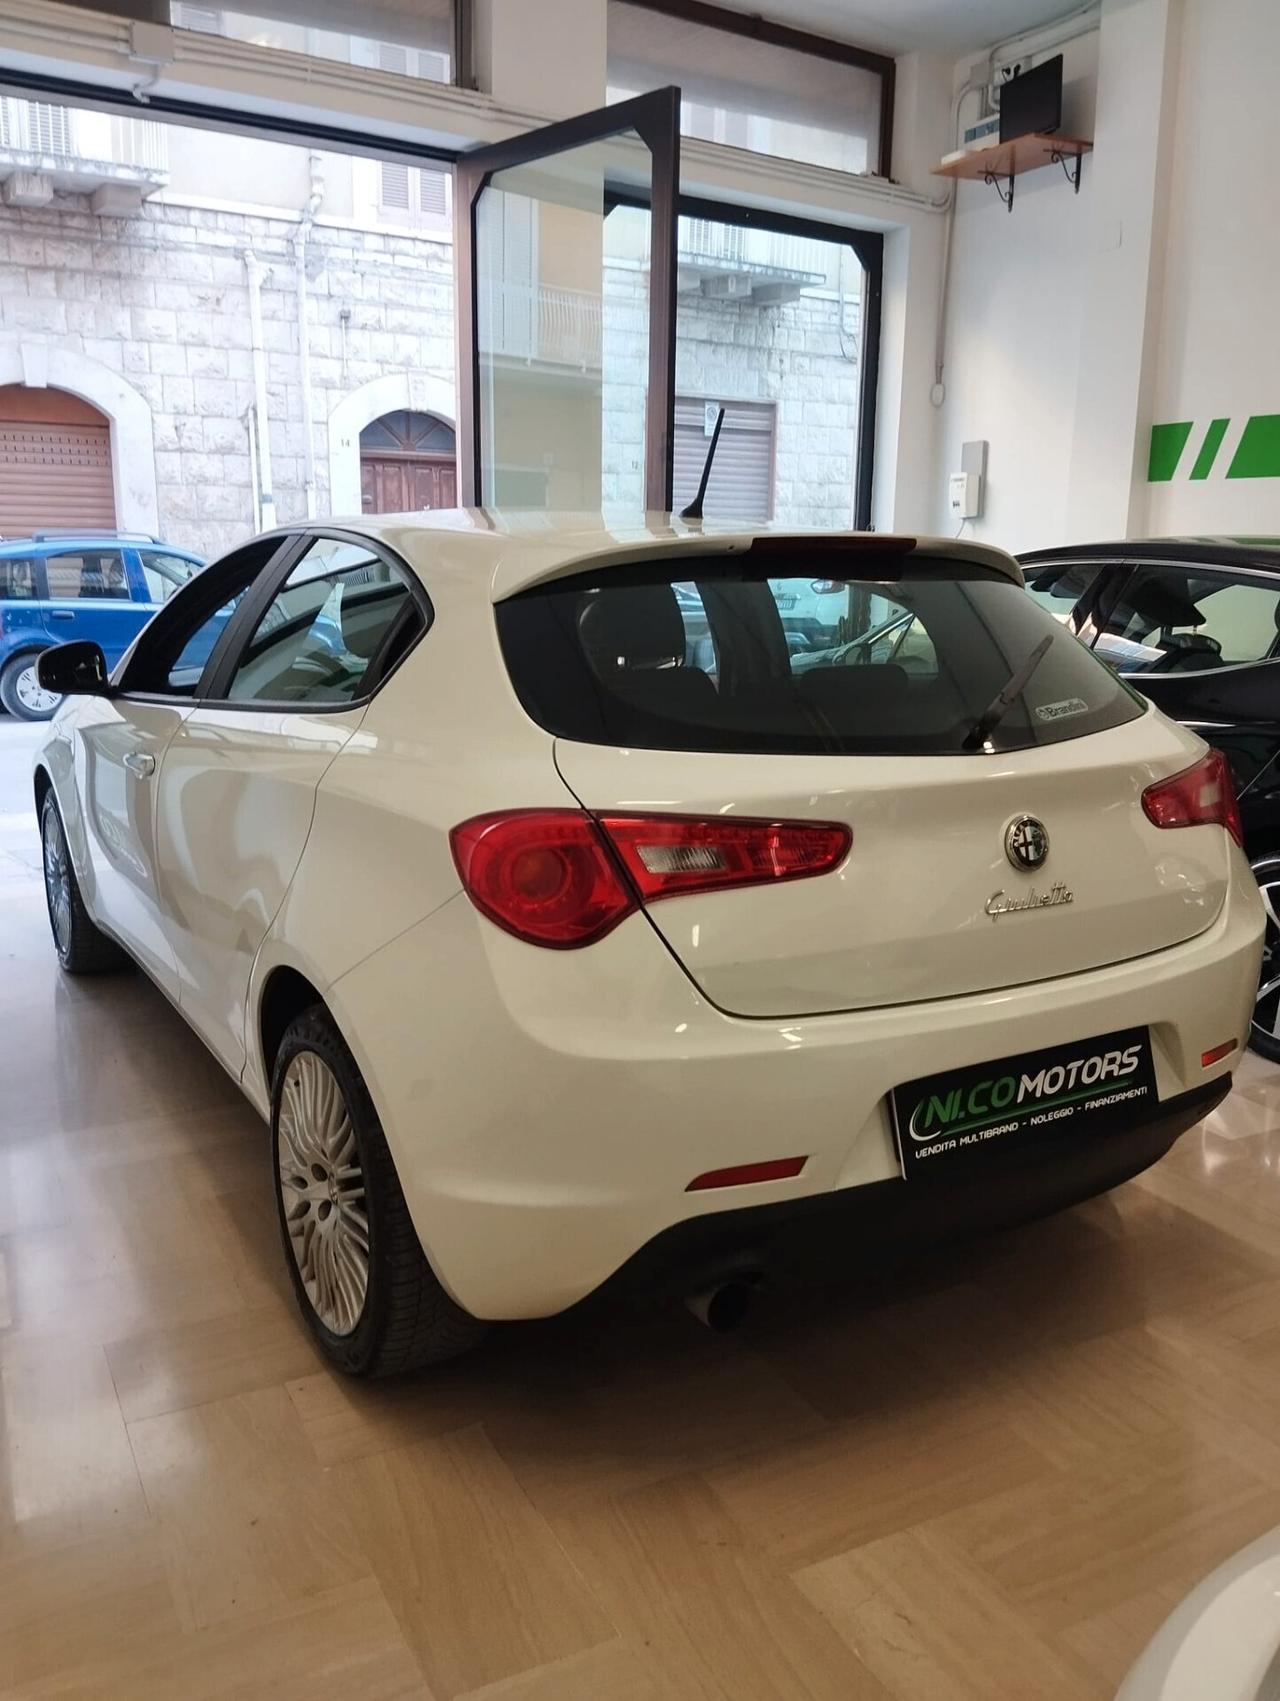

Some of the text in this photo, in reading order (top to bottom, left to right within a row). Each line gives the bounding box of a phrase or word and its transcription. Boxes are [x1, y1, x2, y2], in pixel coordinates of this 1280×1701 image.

[915, 1140, 957, 1160] VENDITA
[959, 1122, 1019, 1147] MULTIBRAND
[1030, 1107, 1074, 1126] NOLEGGIO
[1084, 1086, 1148, 1112] FINANZIAMENTI
